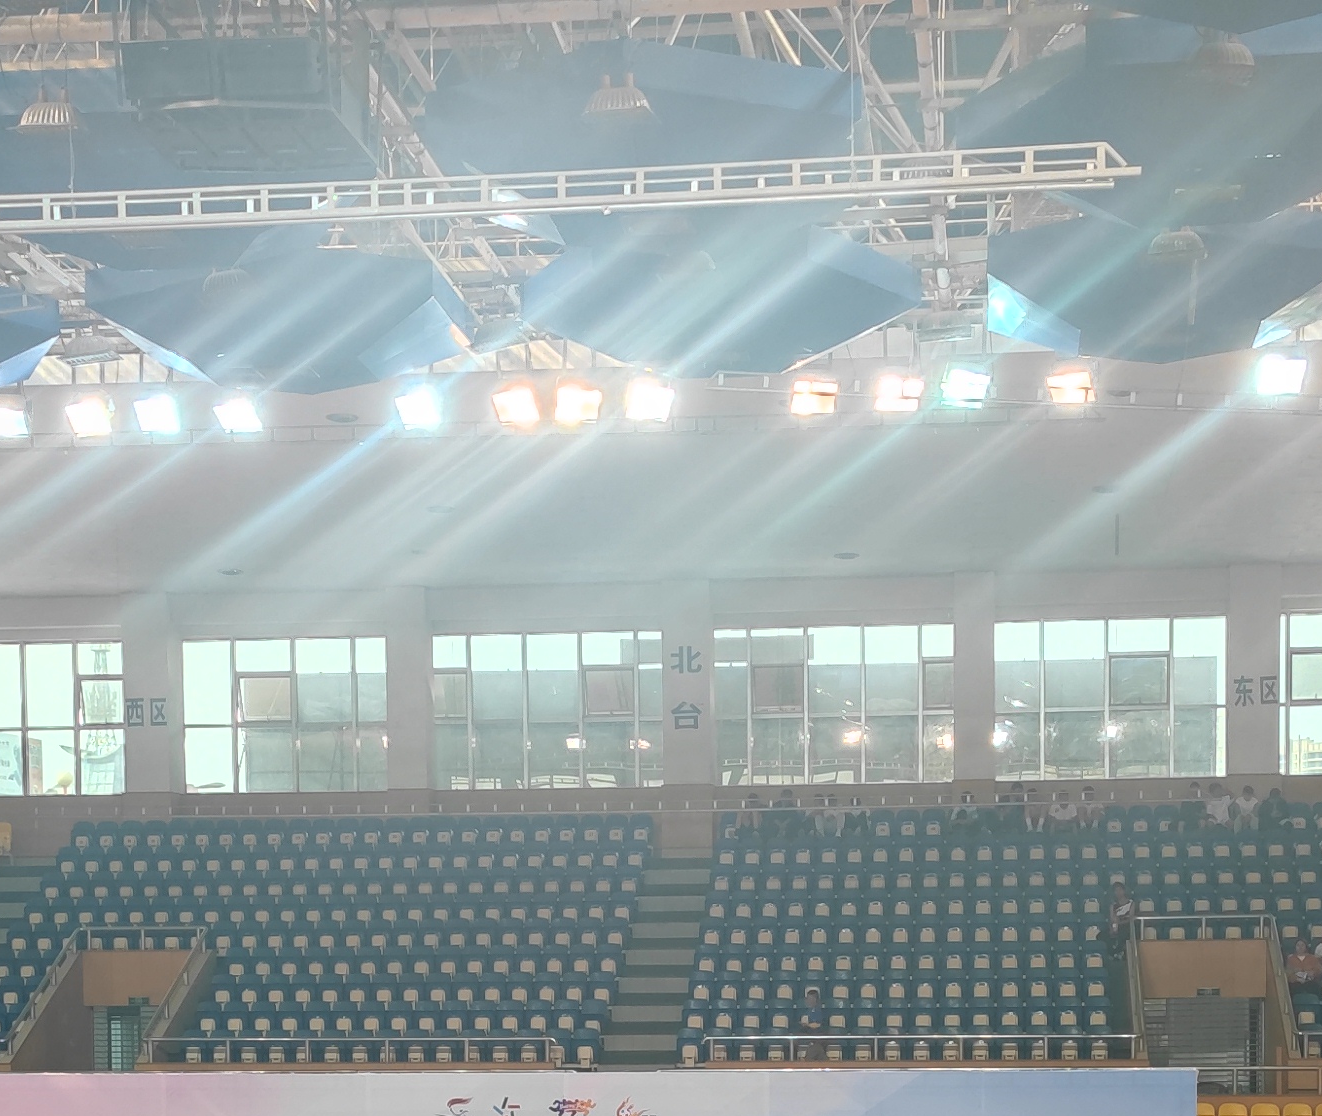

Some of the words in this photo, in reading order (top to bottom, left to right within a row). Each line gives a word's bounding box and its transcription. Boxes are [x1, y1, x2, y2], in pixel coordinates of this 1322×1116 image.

[671, 646, 702, 730] 北台
[1233, 674, 1278, 706] 东区
[126, 697, 167, 728] 西区
